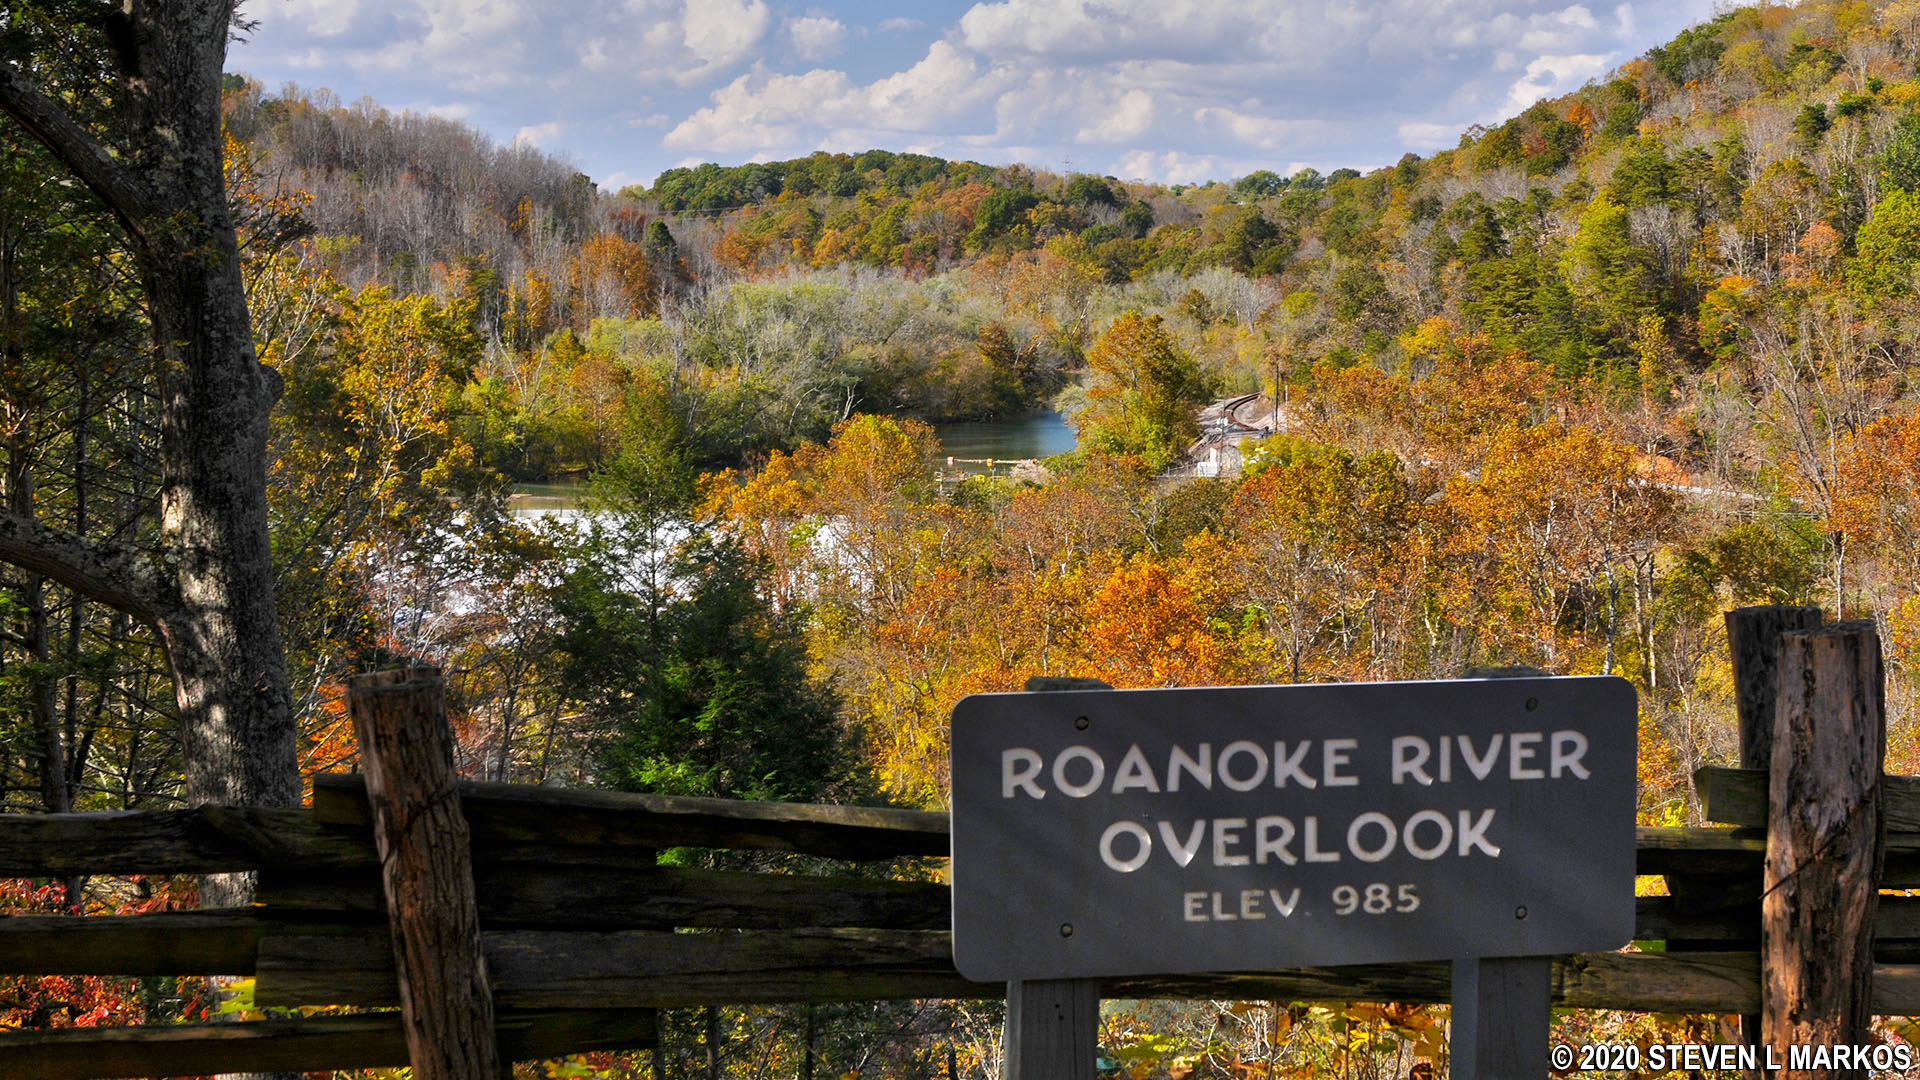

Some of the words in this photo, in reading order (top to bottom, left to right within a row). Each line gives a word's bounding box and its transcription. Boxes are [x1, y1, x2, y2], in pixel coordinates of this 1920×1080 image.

[1001, 738, 1359, 799] ROANOKE
[1391, 730, 1591, 786] RIVER
[1099, 808, 1501, 873] OVERLOOK
[1331, 884, 1421, 915] 985
